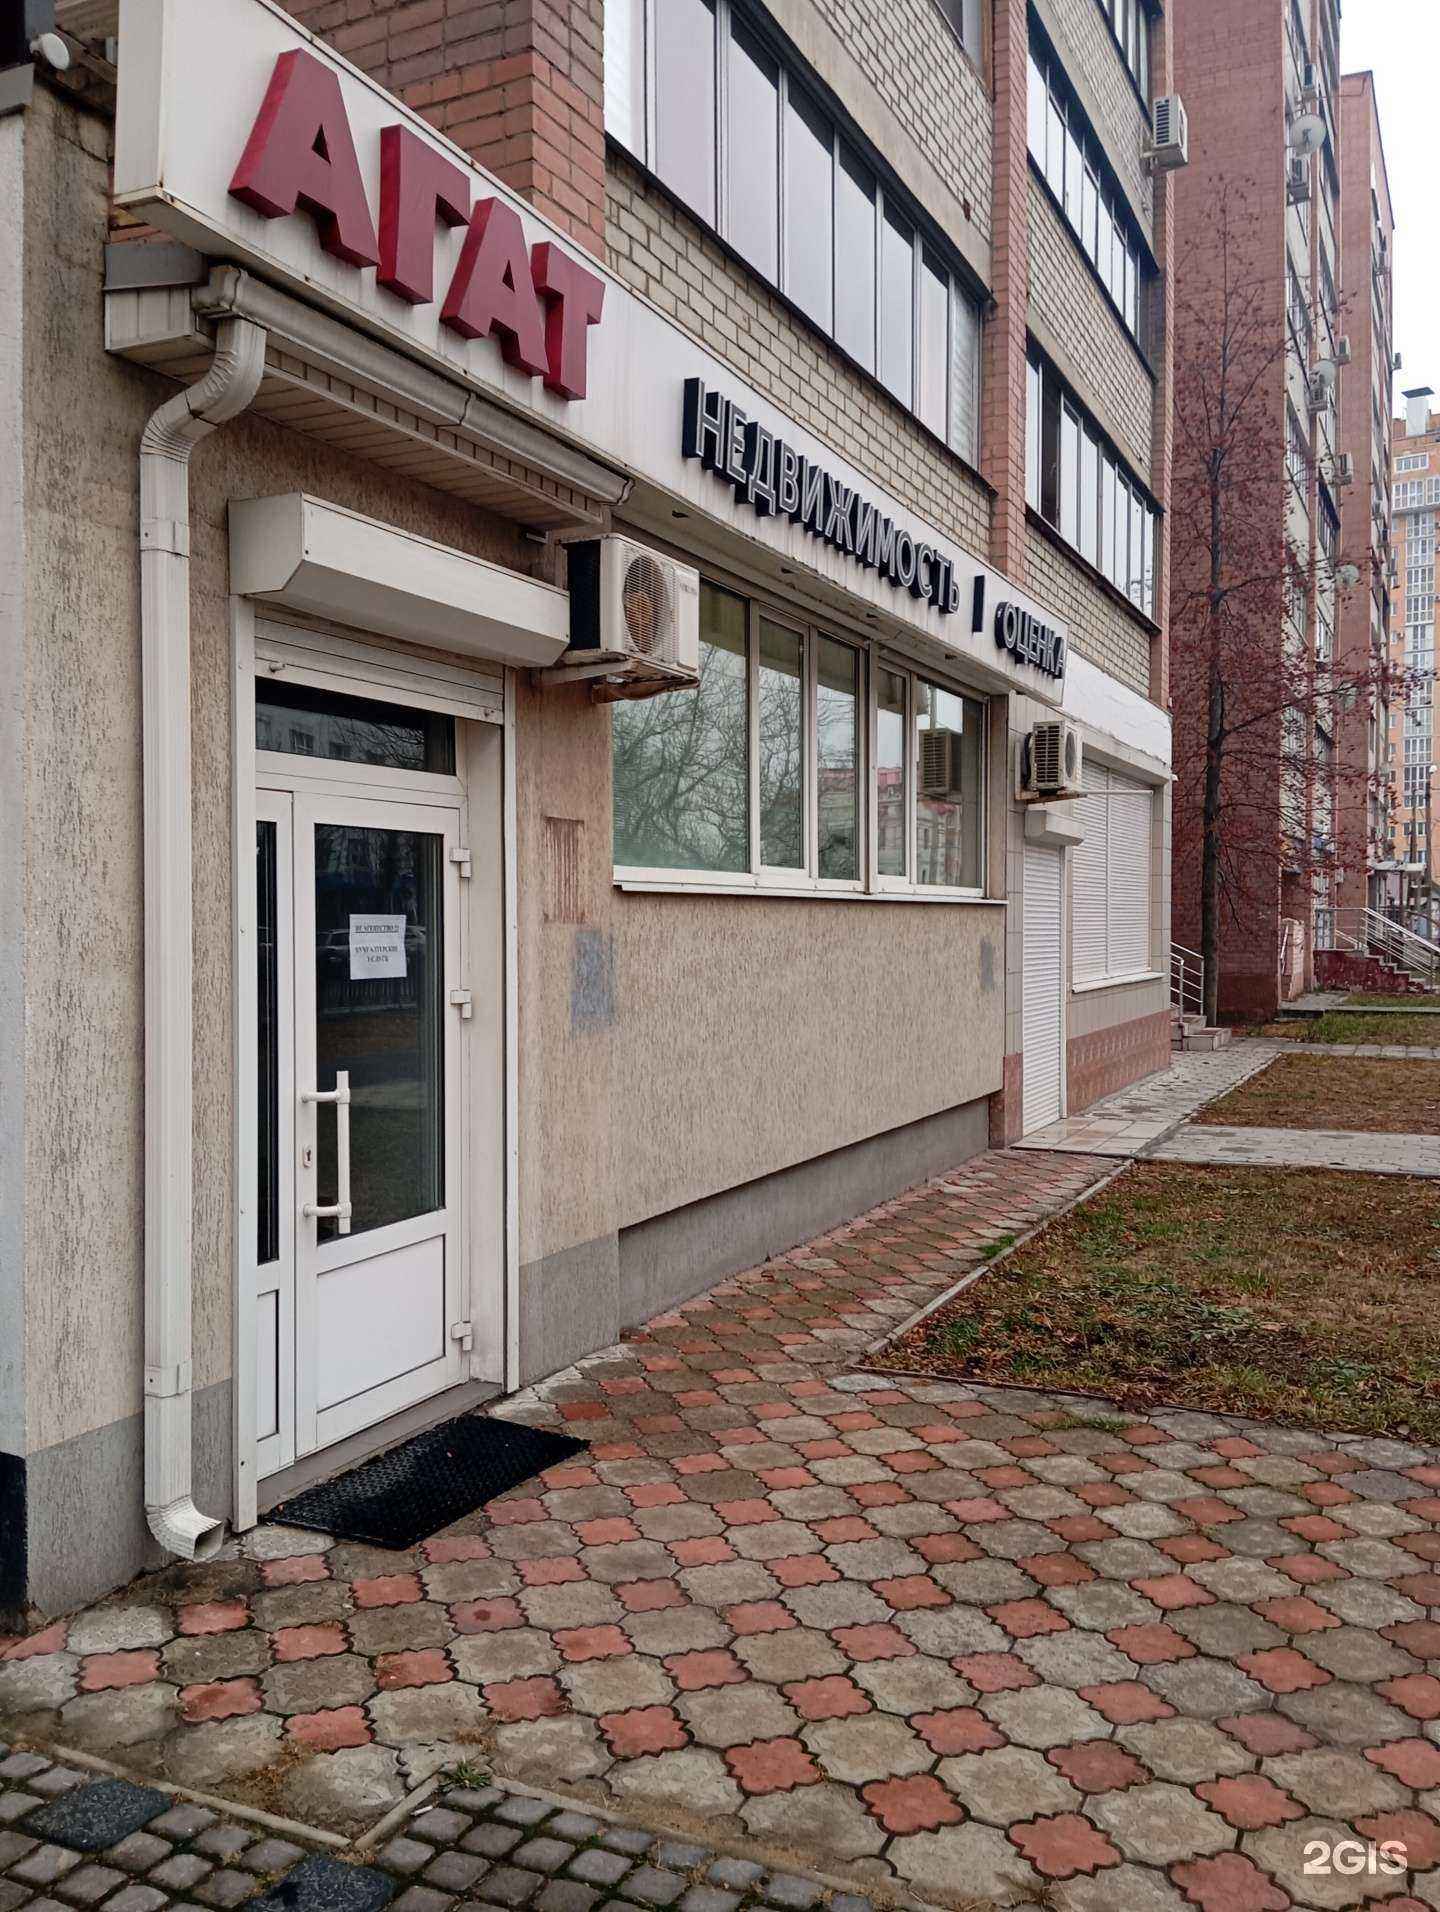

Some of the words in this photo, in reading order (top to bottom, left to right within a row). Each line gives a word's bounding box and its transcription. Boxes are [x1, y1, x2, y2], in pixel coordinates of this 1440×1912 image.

[228, 47, 606, 402] АГАТ
[682, 377, 960, 615] НЕДВИЖИМОСТЬ
[994, 601, 1065, 679] ОЦЕНКА
